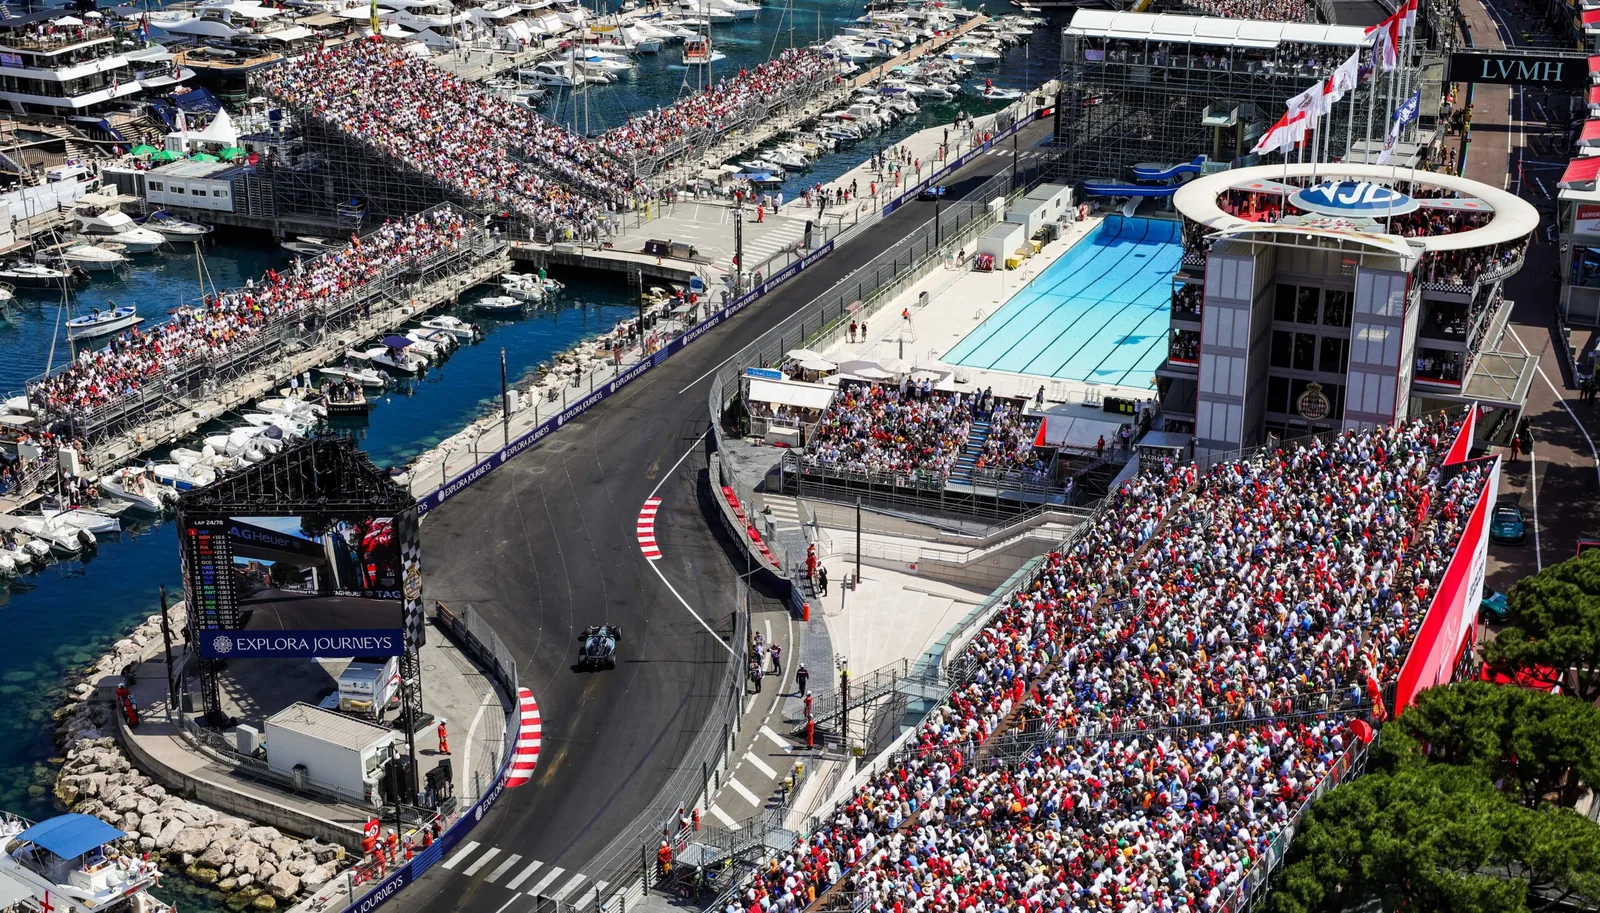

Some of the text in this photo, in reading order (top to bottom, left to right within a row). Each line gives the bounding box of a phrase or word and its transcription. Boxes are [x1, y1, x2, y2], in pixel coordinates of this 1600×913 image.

[1481, 59, 1564, 81] LVMH
[687, 316, 719, 342] EXPLORA JOURNEYS
[615, 360, 652, 389] EXPLORA JOURNEYS
[563, 392, 603, 421] EXPLORA JOURNEYS
[506, 425, 550, 457] EXPLORA JOURNEYS
[444, 462, 492, 497] EXPLORA JOURNEYS
[237, 636, 392, 653] EXPLORA JOURNEYS
